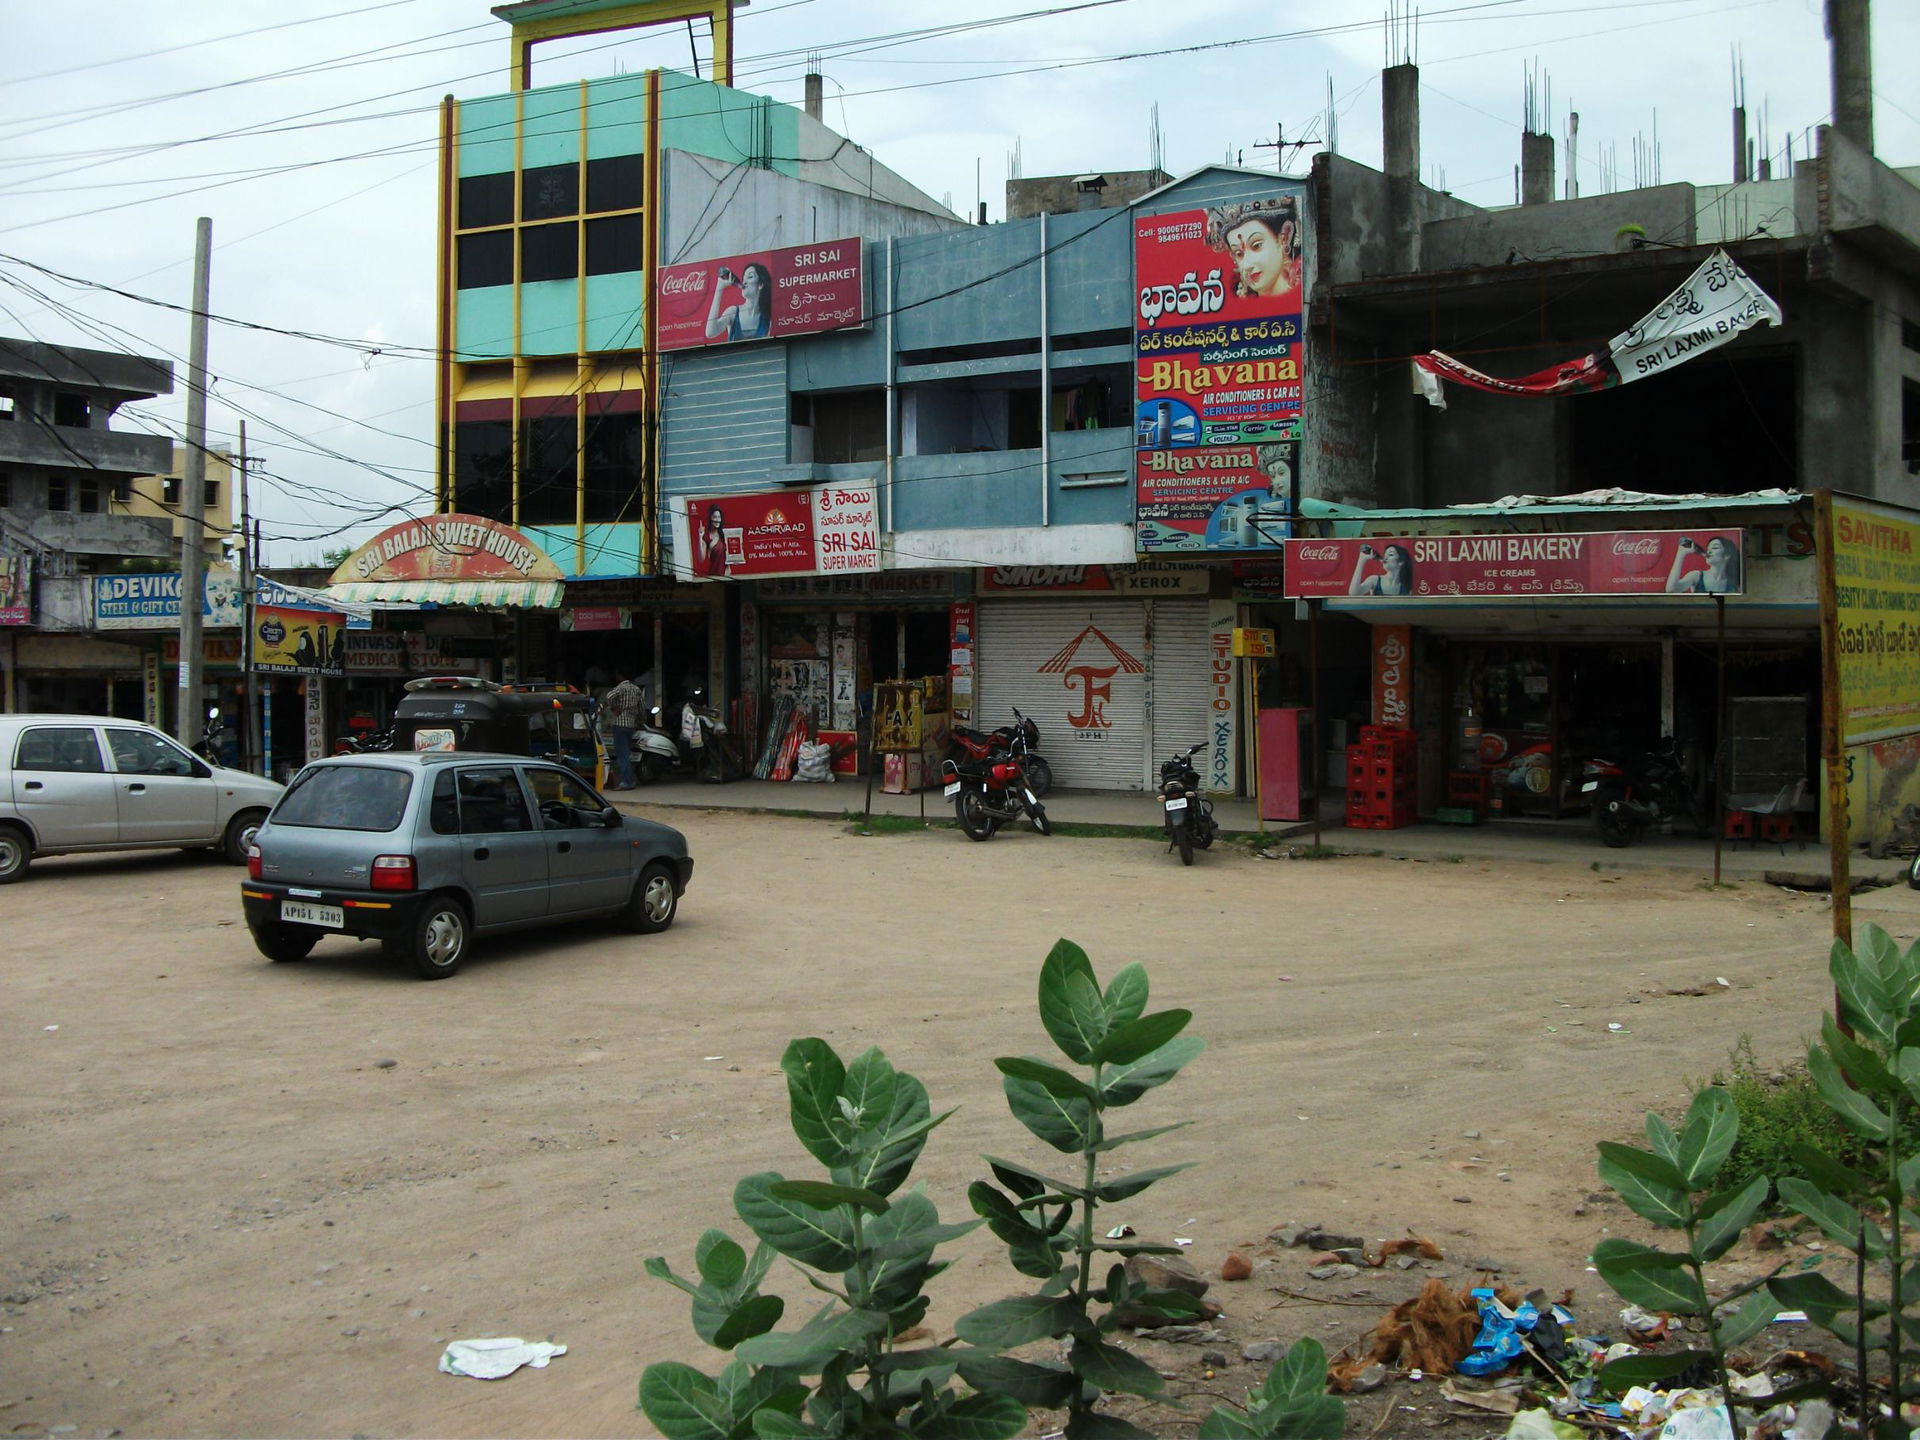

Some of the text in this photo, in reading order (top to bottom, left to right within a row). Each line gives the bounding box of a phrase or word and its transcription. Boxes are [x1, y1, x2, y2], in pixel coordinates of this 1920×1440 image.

[1139, 228, 1156, 238] Cell:
[794, 249, 841, 268] SRI SAI
[779, 267, 857, 289] SUPERMARKET
[1230, 329, 1240, 341] &
[1636, 351, 1663, 374] SRI
[1664, 326, 1715, 360] LAXMI
[1138, 359, 1299, 395] Bhavana
[1203, 393, 1215, 405] AIR
[1216, 388, 1265, 404] CONDITIONERS
[1266, 388, 1272, 400] &
[1273, 386, 1288, 399] CAR
[1203, 401, 1300, 416] SERVICING CENTRE
[1142, 451, 1254, 475] Bhavana
[1142, 479, 1155, 488] AIR
[1156, 476, 1211, 488] CONDITIONERS
[1212, 476, 1219, 485] &
[1220, 475, 1236, 485] CAR
[1152, 486, 1234, 496] SERVICING CENTRE
[748, 522, 806, 536] AASHIRVAAD
[1838, 515, 1913, 554] SAVITHA
[356, 521, 538, 579] SRI BALAJI SWEET HOUSE
[822, 530, 876, 553] SRI SAI
[1414, 537, 1584, 563] SRI LAXMI BAKERY
[823, 553, 877, 571] SUPER MARKET
[1484, 568, 1536, 577] ICE CREAMS
[1129, 576, 1181, 589] XEROX
[1503, 583, 1513, 591] &
[101, 602, 130, 615] STEEL
[132, 601, 139, 613] &
[142, 601, 164, 614] GIFT
[263, 626, 283, 634] Cream
[258, 663, 343, 676] SRI BALAJI SWEET HOUSE
[1212, 633, 1232, 711] STUDIO
[885, 710, 913, 727] FAX
[1213, 721, 1232, 787] XEROX
